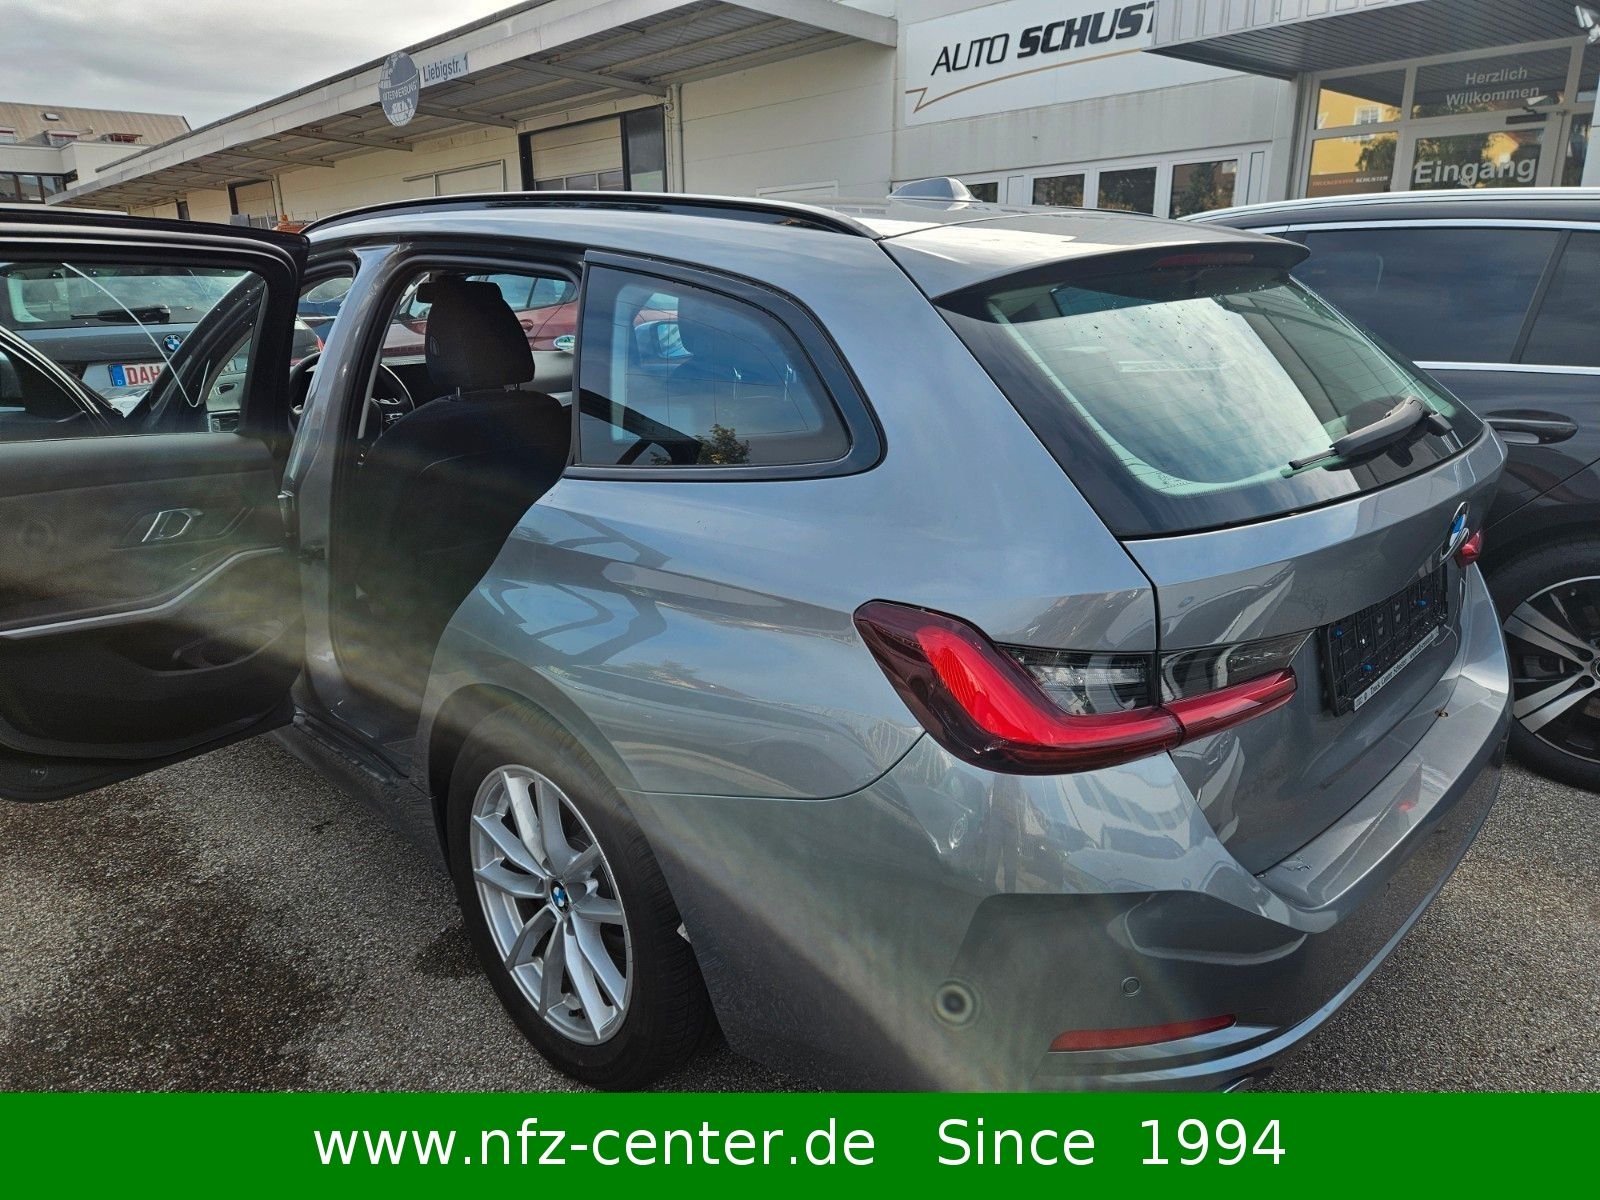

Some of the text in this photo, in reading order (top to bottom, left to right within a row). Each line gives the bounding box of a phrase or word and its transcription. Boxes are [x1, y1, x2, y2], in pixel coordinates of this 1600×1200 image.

[931, 33, 1010, 76] AUTO
[422, 58, 461, 82] Liebigstr.
[1465, 66, 1528, 86] Herzlich
[1446, 86, 1540, 107] Willkommen
[1414, 156, 1537, 187] Eingang
